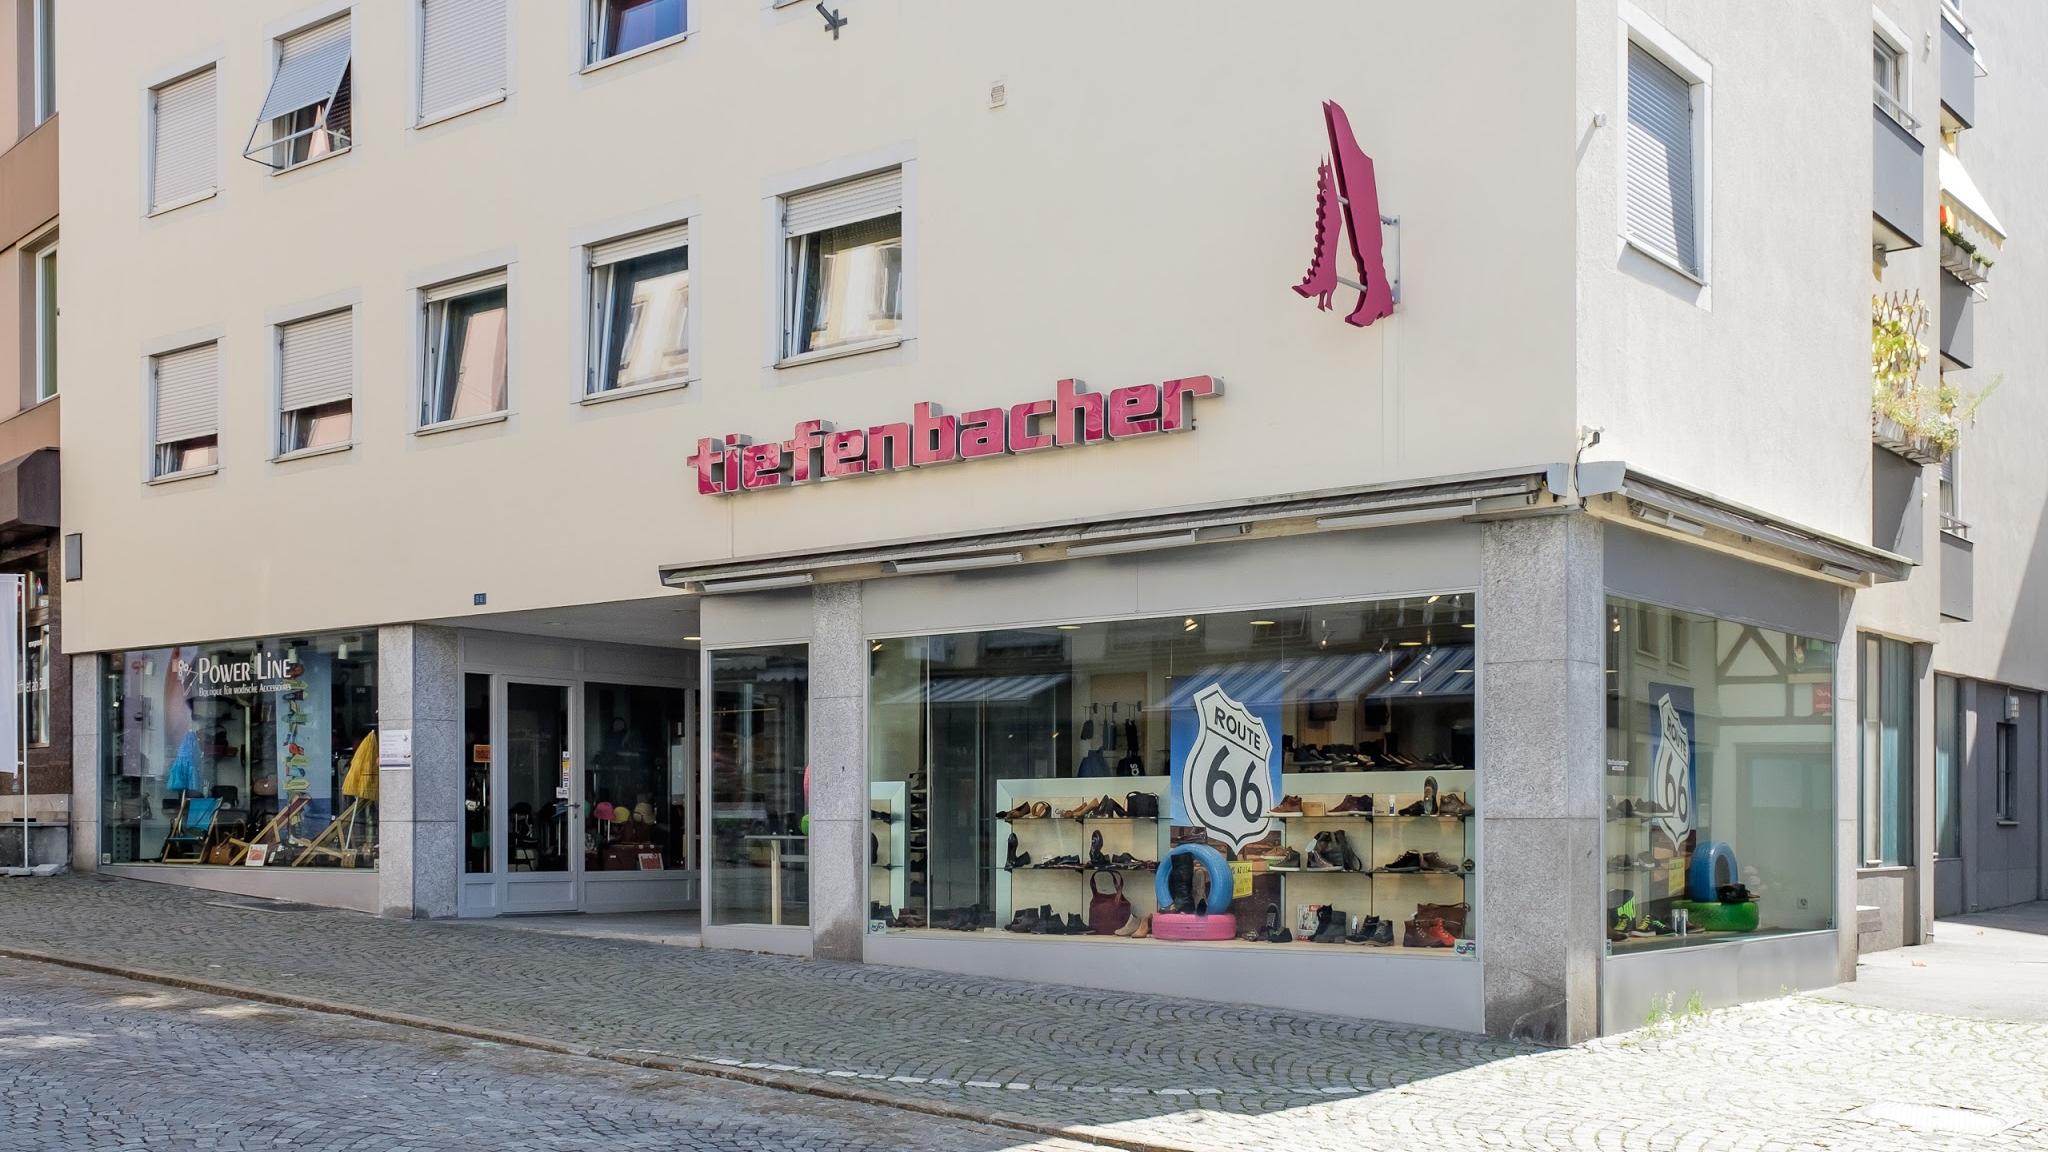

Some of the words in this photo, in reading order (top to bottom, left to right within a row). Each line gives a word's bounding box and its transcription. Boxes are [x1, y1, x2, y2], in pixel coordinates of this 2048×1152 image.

[686, 374, 1222, 496] tiefenbacher
[223, 684, 232, 695] für
[1214, 705, 1261, 751] ROUTE
[1666, 715, 1688, 758] ROUTE
[1205, 745, 1263, 824] 66
[1665, 751, 1687, 823] 66
